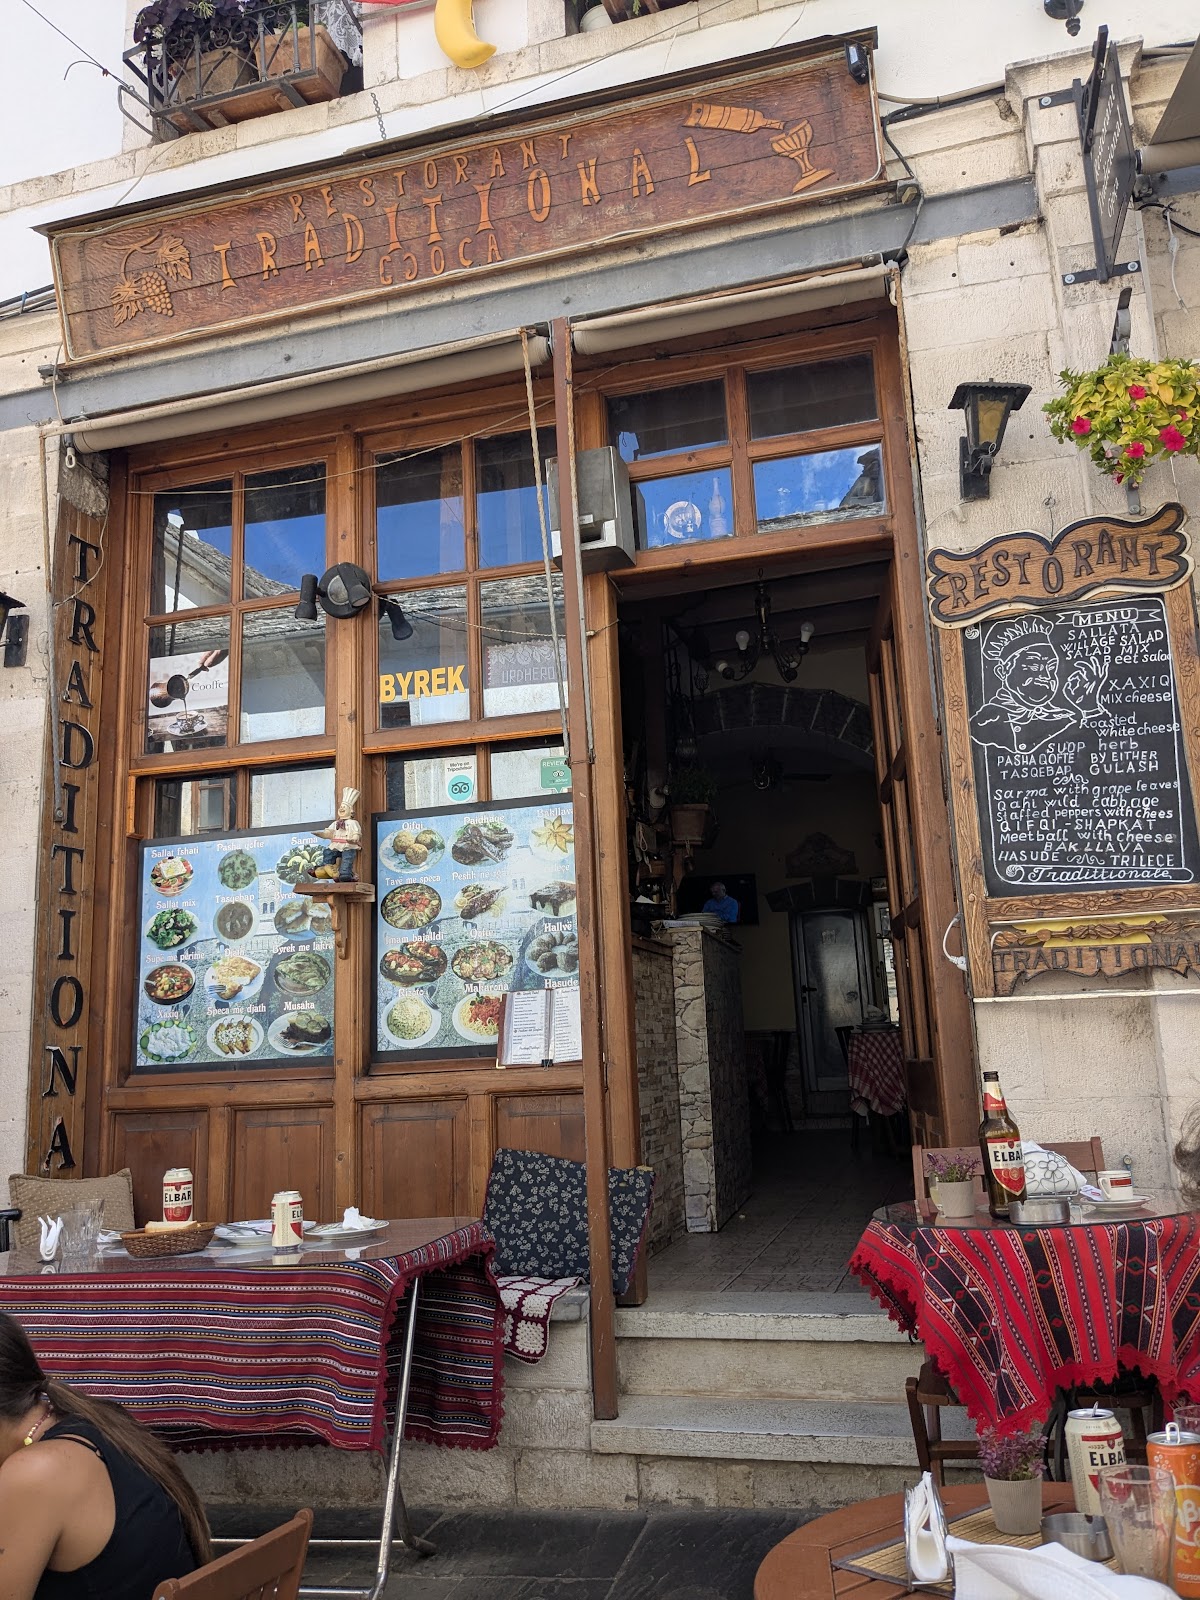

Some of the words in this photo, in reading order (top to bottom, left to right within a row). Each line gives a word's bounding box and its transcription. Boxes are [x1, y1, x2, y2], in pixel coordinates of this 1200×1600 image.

[289, 134, 573, 223] RESTORANT
[213, 137, 712, 291] TRADITIONAL
[950, 529, 1164, 609] RESTORANT
[1078, 610, 1132, 626] MENU
[1060, 636, 1116, 653] WILLAGE
[1119, 629, 1164, 647] SALAD
[1065, 646, 1112, 661] SALAD
[1120, 643, 1151, 656] MIX
[191, 679, 224, 693] Cooffe
[380, 664, 466, 704] BYREK
[1108, 674, 1170, 692] XAXIQ
[1100, 692, 1122, 705] MIX
[1125, 690, 1172, 704] cheese
[1079, 711, 1138, 729] Roasted
[1095, 727, 1136, 738] white
[1137, 721, 1181, 737] cheese
[1046, 741, 1086, 754] SUOP
[1098, 737, 1139, 751] herb
[997, 754, 1037, 768] PASHA
[1038, 752, 1076, 767] QOFTE
[1090, 752, 1107, 764] BY
[1111, 750, 1158, 762] EITHER
[1000, 764, 1072, 781] TASQEBAP
[1089, 760, 1159, 776] GULASH
[993, 786, 1049, 801] Sarma
[1053, 783, 1089, 796] with
[1091, 784, 1132, 799] grape
[1136, 779, 1179, 792] leaves
[1044, 794, 1080, 808] wild
[1092, 793, 1160, 810] cabbage
[1054, 807, 1102, 822] peppers
[1103, 805, 1133, 818] with
[1134, 806, 1174, 819] chees
[1000, 819, 1056, 833] QIFQI
[290, 836, 319, 846] Sarma
[999, 828, 1070, 845] Meetball
[1076, 829, 1113, 842] with
[1116, 829, 1175, 844] cheese
[151, 849, 174, 859] Sallat
[177, 846, 200, 856] fshati
[1043, 841, 1145, 853] BAKLLAVA
[997, 850, 1061, 862] HASUDE
[419, 874, 441, 885] speca
[451, 870, 476, 881] Peshk
[156, 901, 179, 910] Sallat
[181, 899, 196, 907] mix
[543, 922, 573, 933] Hallvë
[272, 942, 297, 955] Byrek
[298, 944, 311, 952] me
[167, 954, 178, 962] me
[464, 982, 509, 993] Makarona
[544, 977, 579, 989] Hasude
[232, 1007, 244, 1015] me
[246, 1003, 267, 1014] djath
[282, 1001, 316, 1011] Musaka
[164, 1190, 192, 1202] ELBAR
